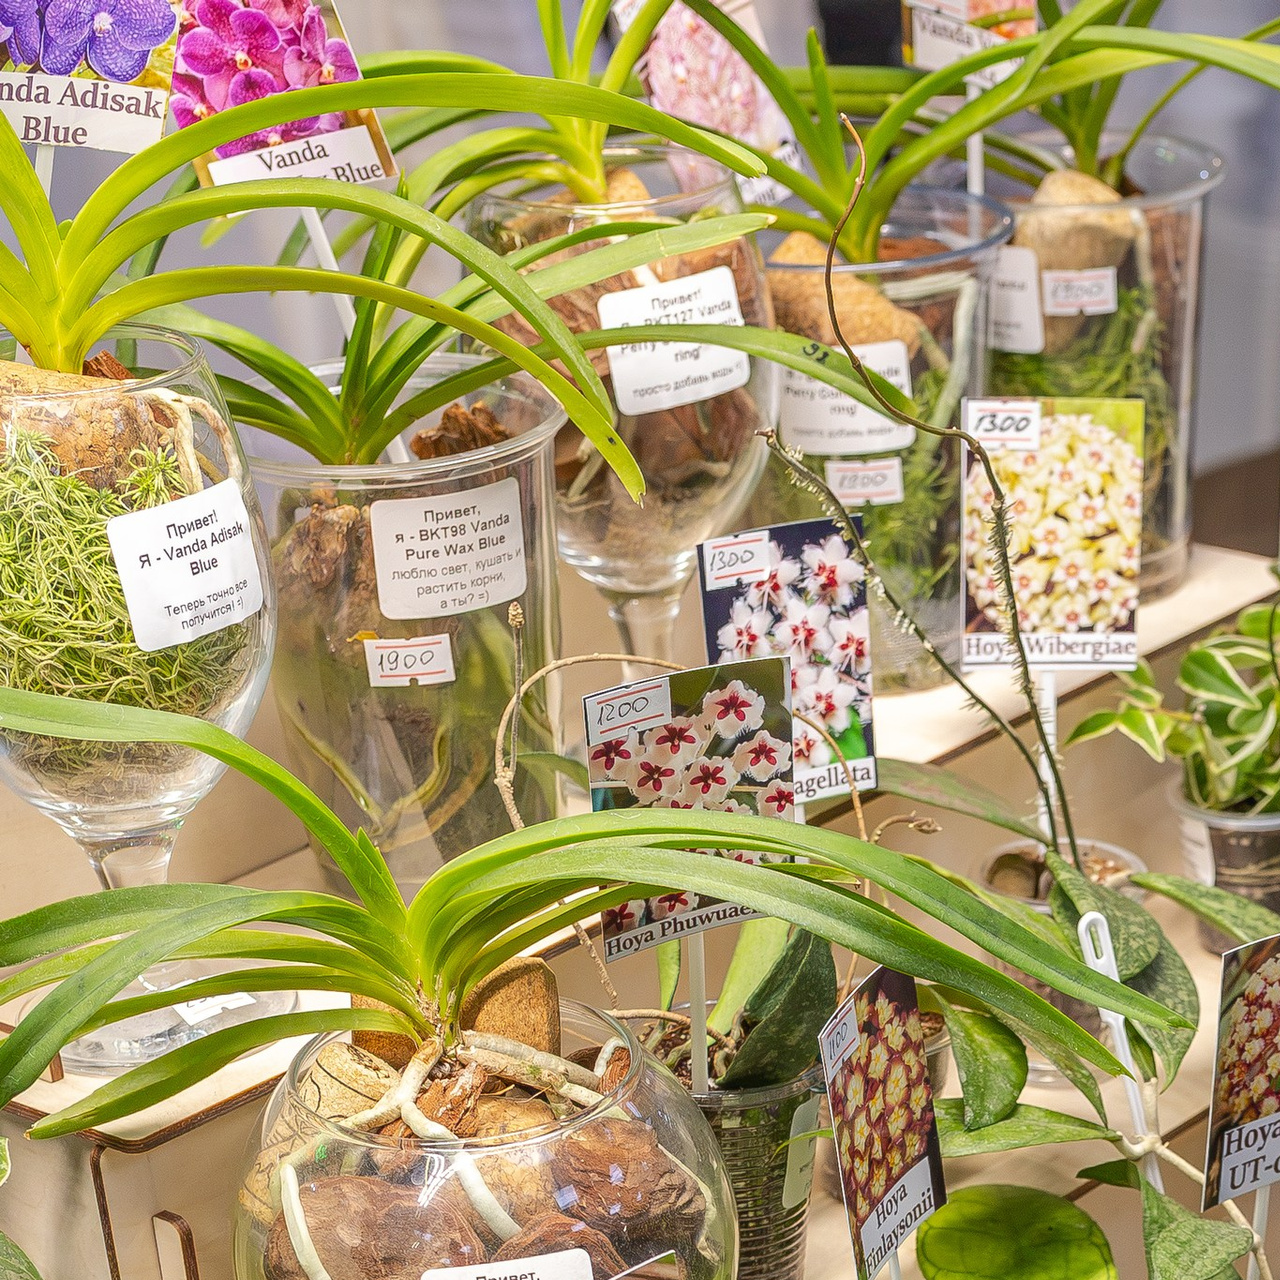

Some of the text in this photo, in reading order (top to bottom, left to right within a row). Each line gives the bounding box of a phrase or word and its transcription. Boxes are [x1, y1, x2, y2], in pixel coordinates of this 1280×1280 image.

[0, 82, 161, 118] nda Adisak
[22, 114, 87, 145] Blue
[258, 138, 329, 172] Vanda
[974, 411, 1031, 435] 1300
[166, 509, 219, 539] Привет!
[424, 506, 481, 524] Привет,
[471, 513, 510, 532] Vanda
[164, 537, 207, 564] Vanda
[210, 519, 244, 549] Adisak
[405, 533, 506, 561] Pure Wax Blue
[190, 556, 218, 576] Blue
[392, 565, 438, 581] люблю
[442, 562, 472, 578] свет,
[475, 553, 512, 573] кушать
[708, 547, 756, 572] 1300
[165, 578, 248, 618] Теперь точно все
[417, 572, 506, 599] растить корни,
[451, 593, 475, 608] ты?
[181, 600, 235, 631] получится!
[1027, 635, 1137, 659] Wibergiae
[378, 650, 435, 673] 1900
[596, 694, 651, 726] 1200
[794, 763, 873, 797] agellata
[606, 928, 657, 956] Hoya
[875, 1181, 908, 1229] Hoya
[865, 1188, 935, 1279] Finlaysonii
